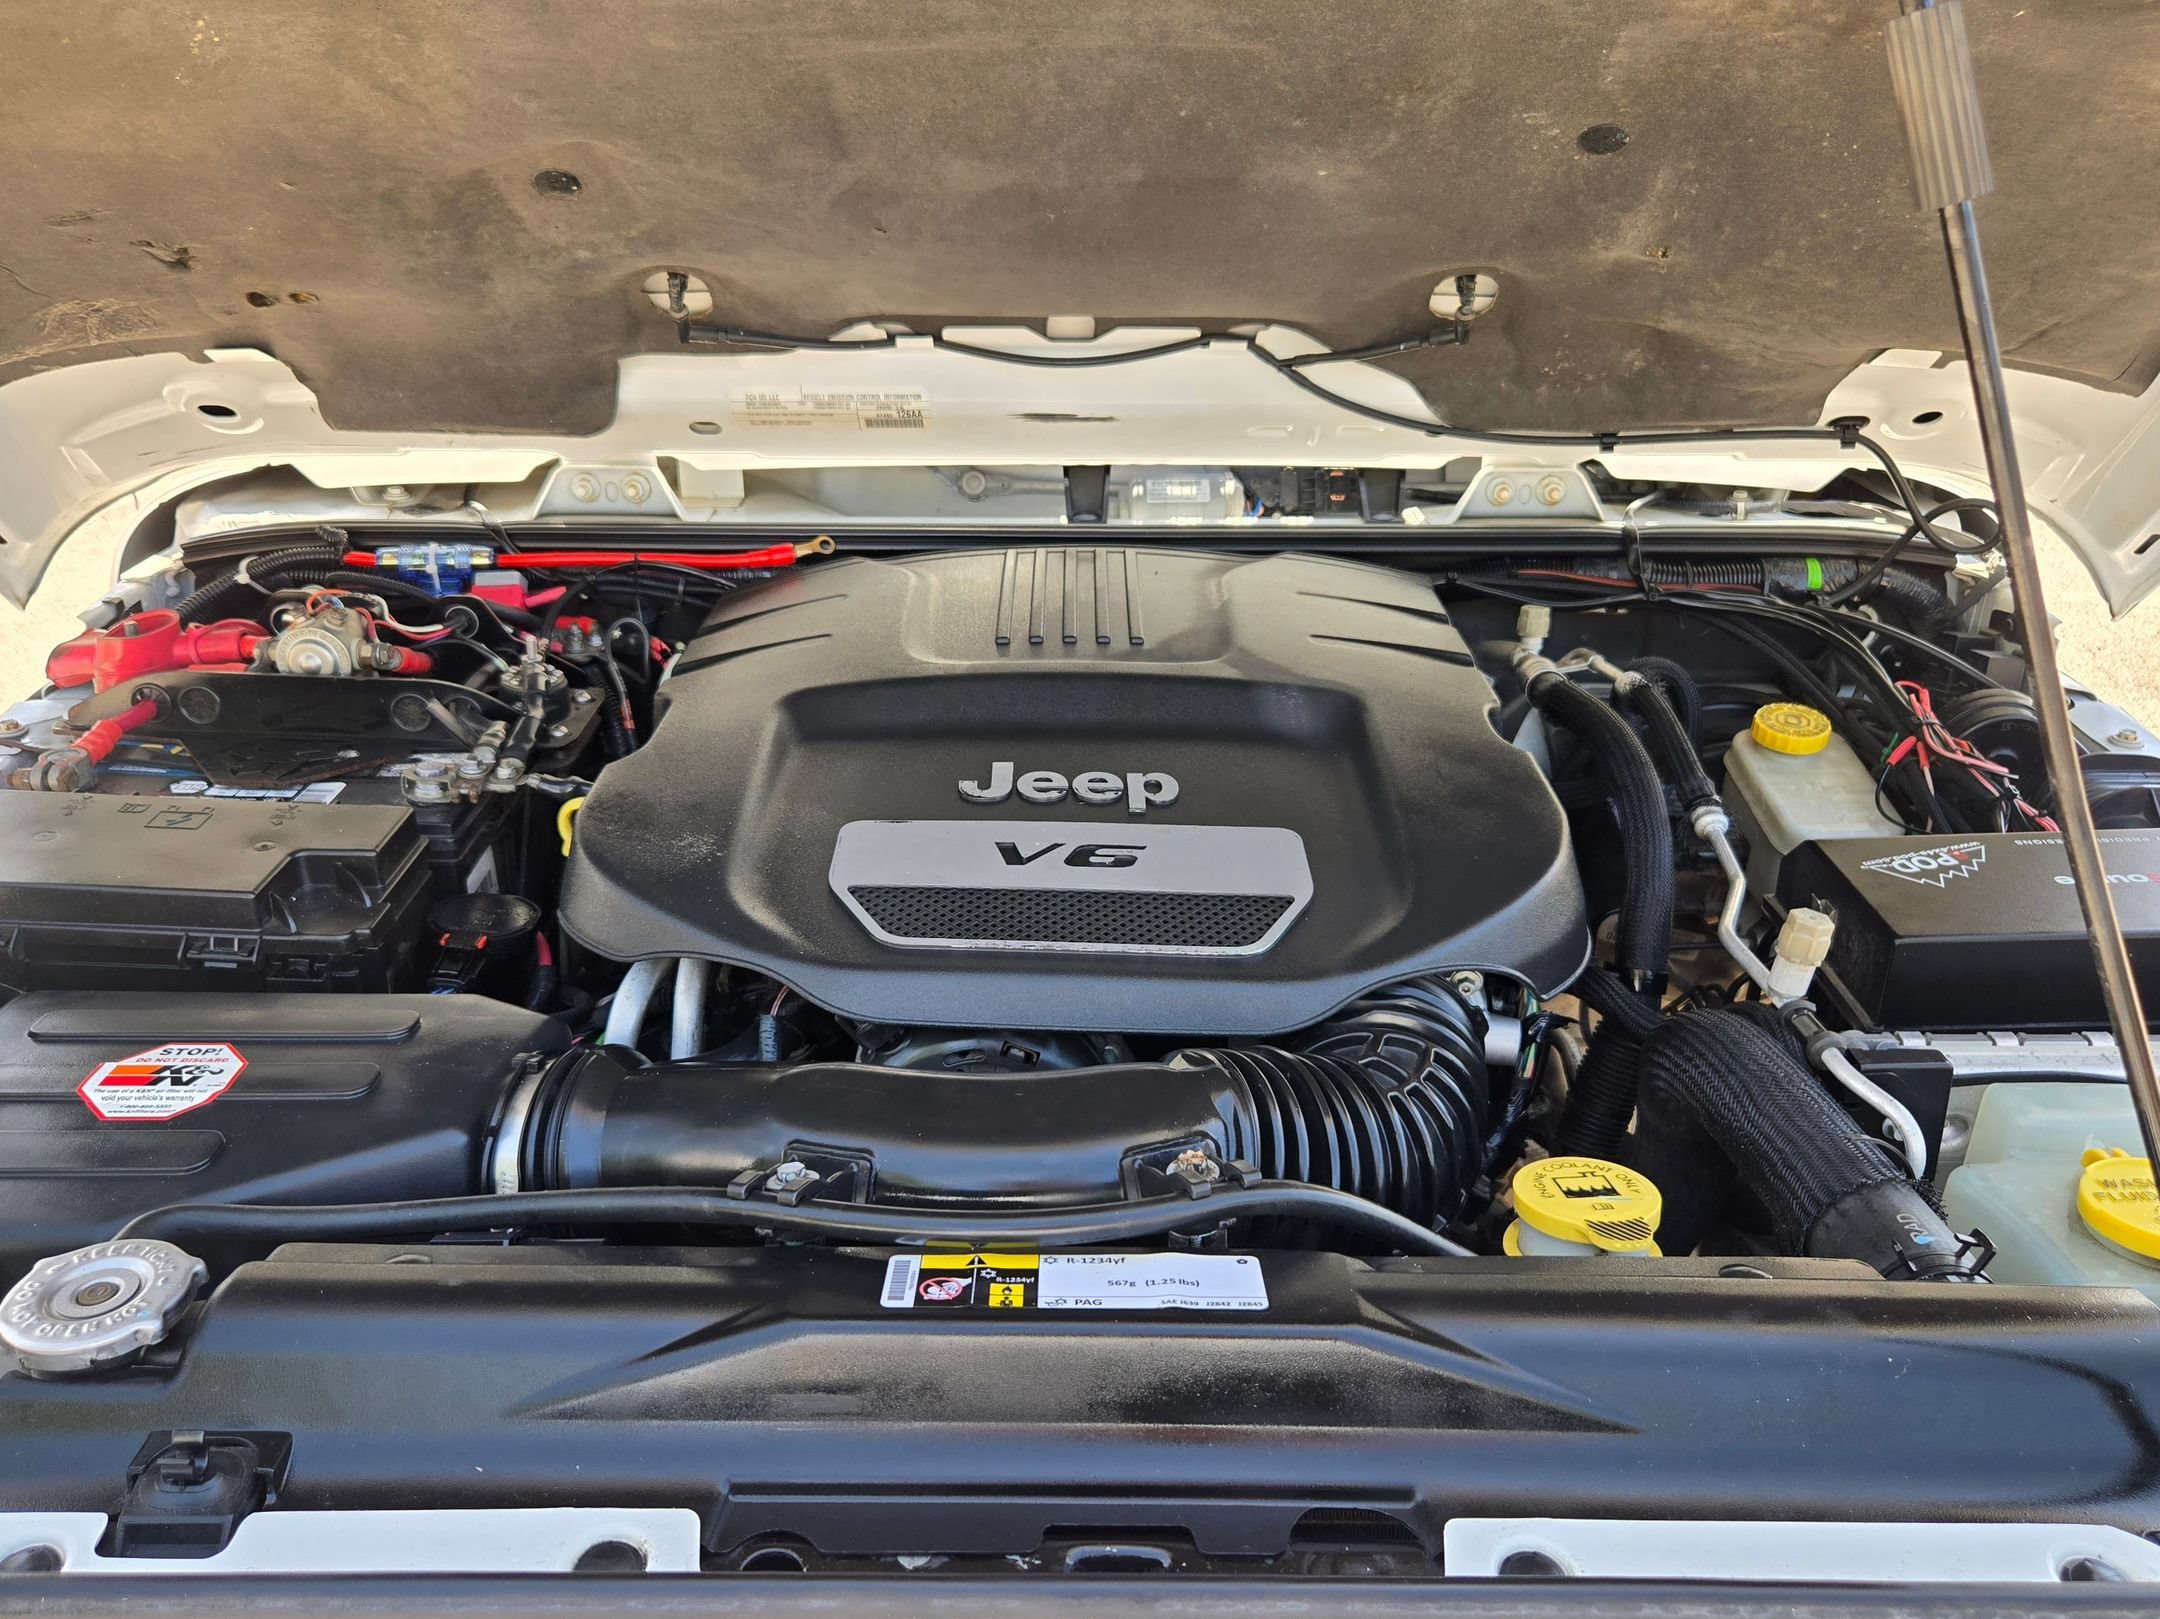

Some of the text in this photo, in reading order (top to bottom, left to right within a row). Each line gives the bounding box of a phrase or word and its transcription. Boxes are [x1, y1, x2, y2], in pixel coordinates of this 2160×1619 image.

[803, 393, 922, 401] VEHICLE EMISSION CONTROL INFORMATION
[896, 409, 923, 419] 126AA
[958, 761, 1180, 815] Jeep
[2013, 838, 2065, 846] ESIGNS
[993, 841, 1148, 869] V6
[159, 1047, 224, 1056] STOP!
[146, 1065, 224, 1087] K&N
[101, 1094, 195, 1103] void your vehicle's warranty
[1532, 1161, 1641, 1199] ENGINE COOLANT ONLY
[2093, 1190, 2158, 1203] FLUID
[73, 1244, 133, 1263] KEEP
[1066, 1256, 1126, 1266] R-1234yf
[995, 1276, 1036, 1284] R-1234yf
[1107, 1278, 1200, 1288] 567g (1.25 lbs)
[1074, 1298, 1103, 1307] PAG
[34, 1320, 98, 1338] OPEN
